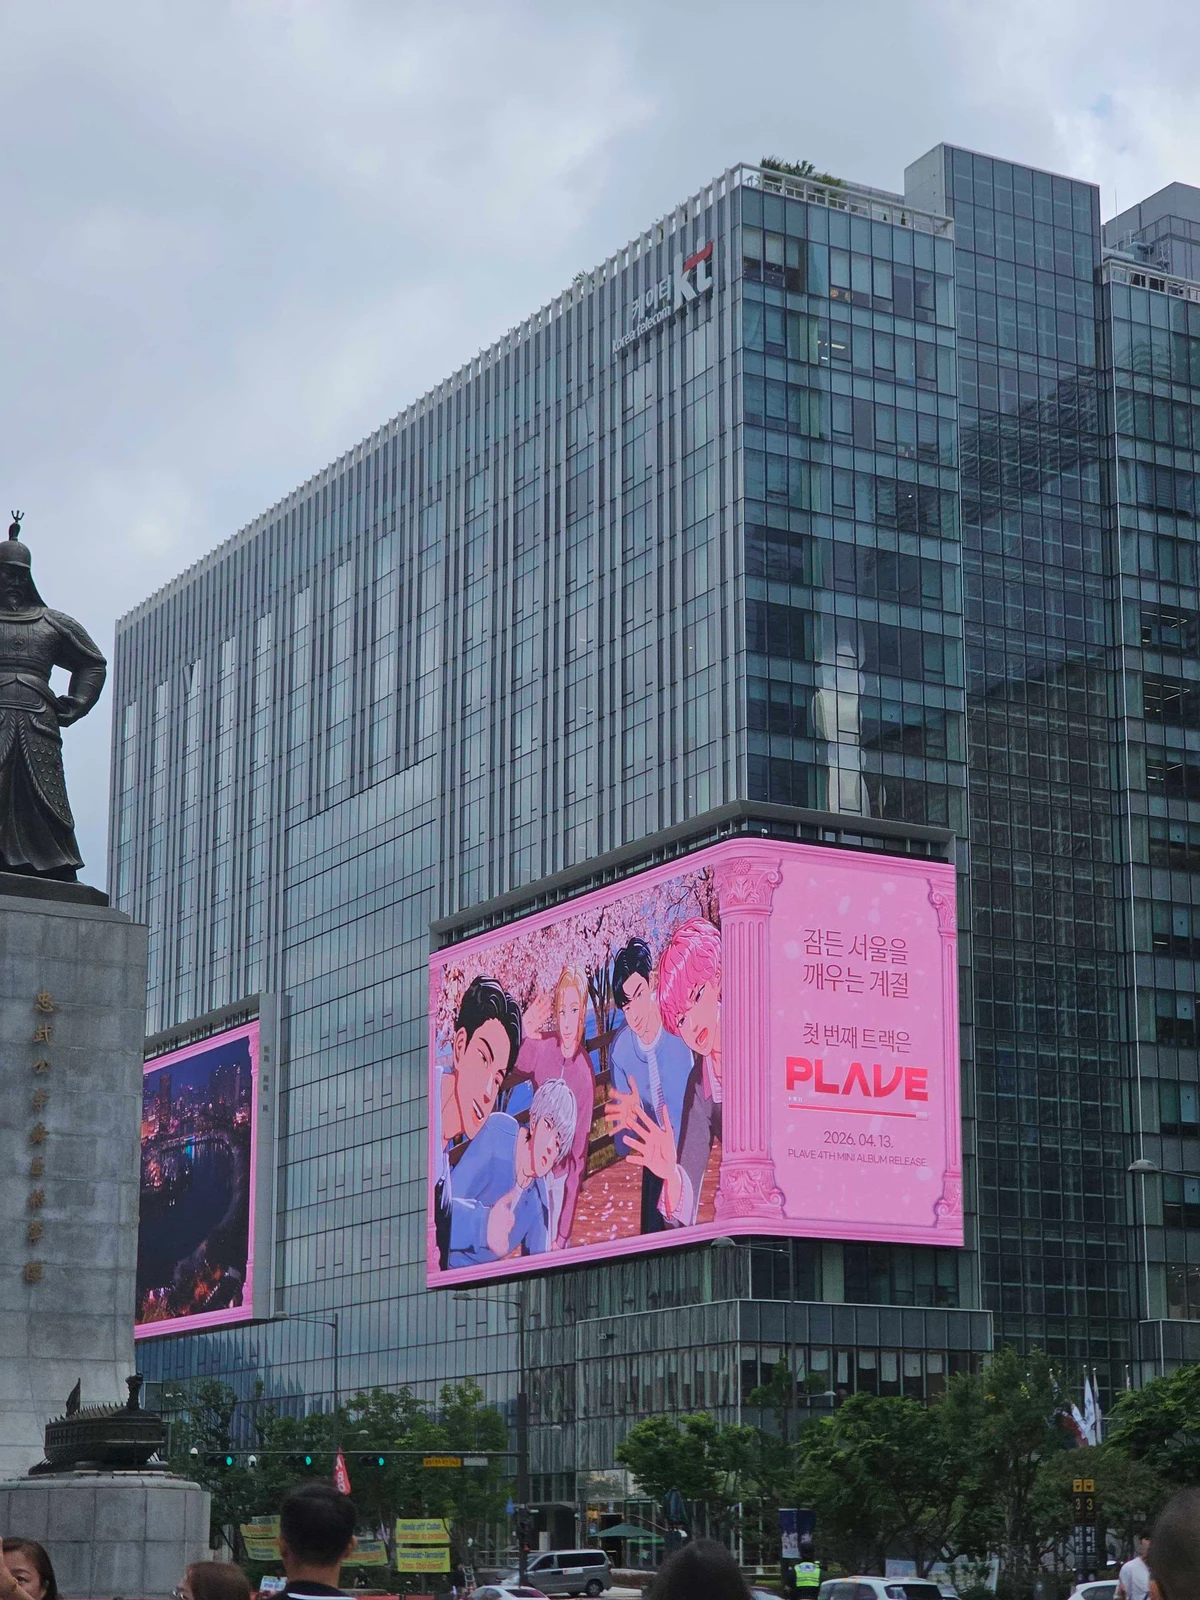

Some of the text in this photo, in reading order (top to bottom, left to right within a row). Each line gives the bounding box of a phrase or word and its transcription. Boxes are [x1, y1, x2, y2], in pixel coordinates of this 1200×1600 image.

[612, 305, 671, 354] korea telecom
[803, 928, 909, 965] 잠든 서울을
[803, 962, 909, 999] 깨우는 계절
[802, 1022, 912, 1053] 첫 번째 트랙은
[786, 1056, 928, 1101] PLAVE
[823, 1130, 894, 1149] 2026. 04. 13.
[787, 1148, 928, 1167] PLAVE 4TH MINI ALBUM RELEASE
[1086, 1498, 1093, 1510] 3
